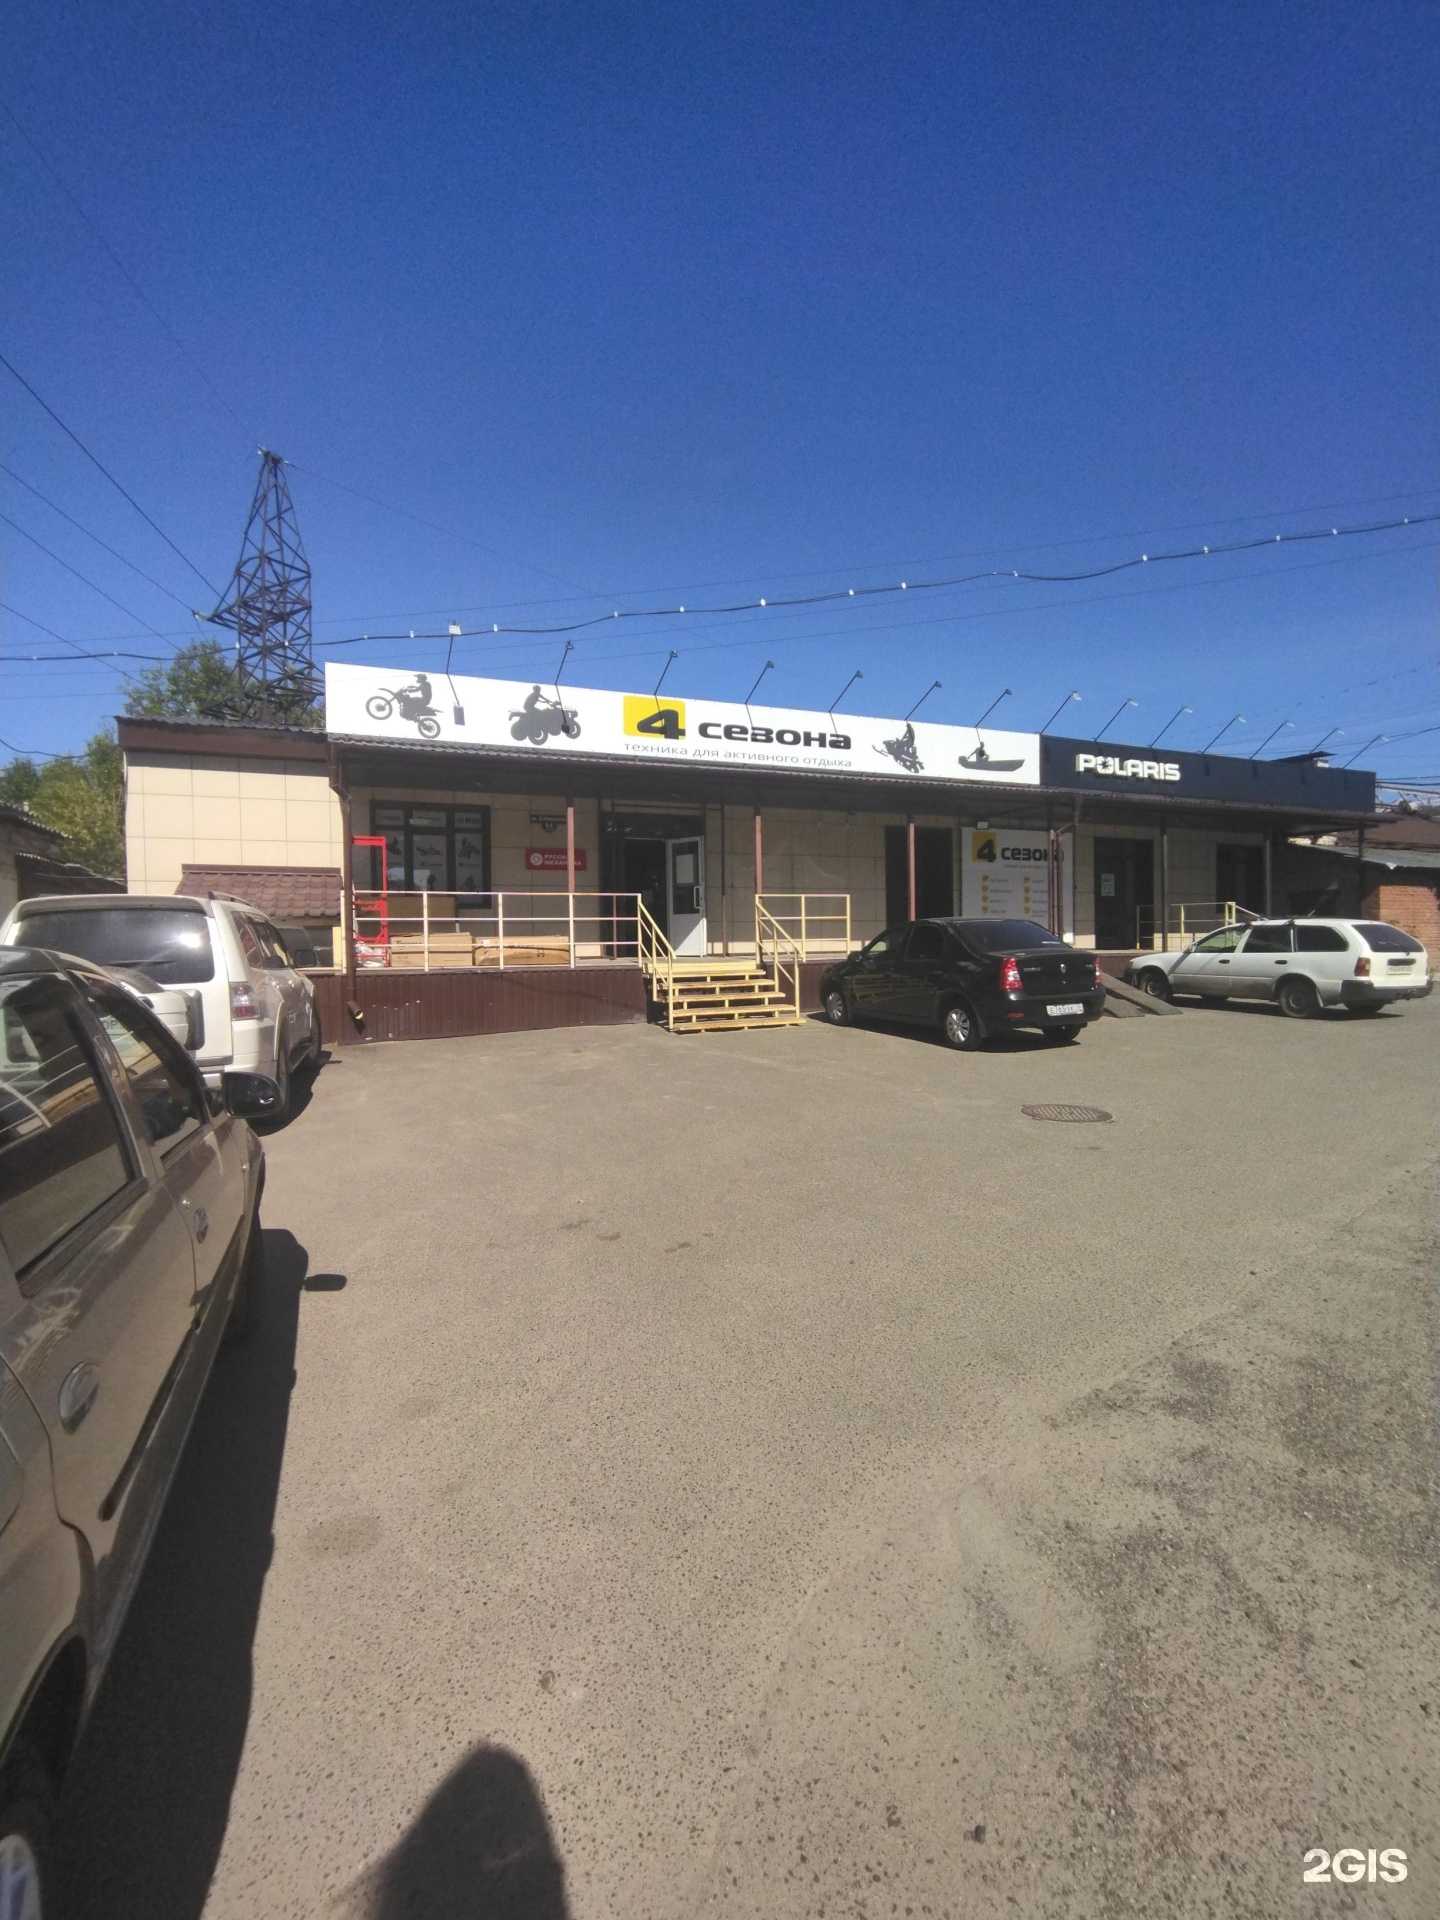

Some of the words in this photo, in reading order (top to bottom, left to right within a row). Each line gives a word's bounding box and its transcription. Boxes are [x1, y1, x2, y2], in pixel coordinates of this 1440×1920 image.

[637, 708, 686, 740] 4
[698, 722, 852, 751] сезона
[624, 743, 688, 756] техника
[692, 748, 719, 758] для
[723, 750, 800, 764] активного
[803, 756, 852, 769] отдыха
[1075, 753, 1181, 781] POLARIS
[976, 838, 997, 862] 4
